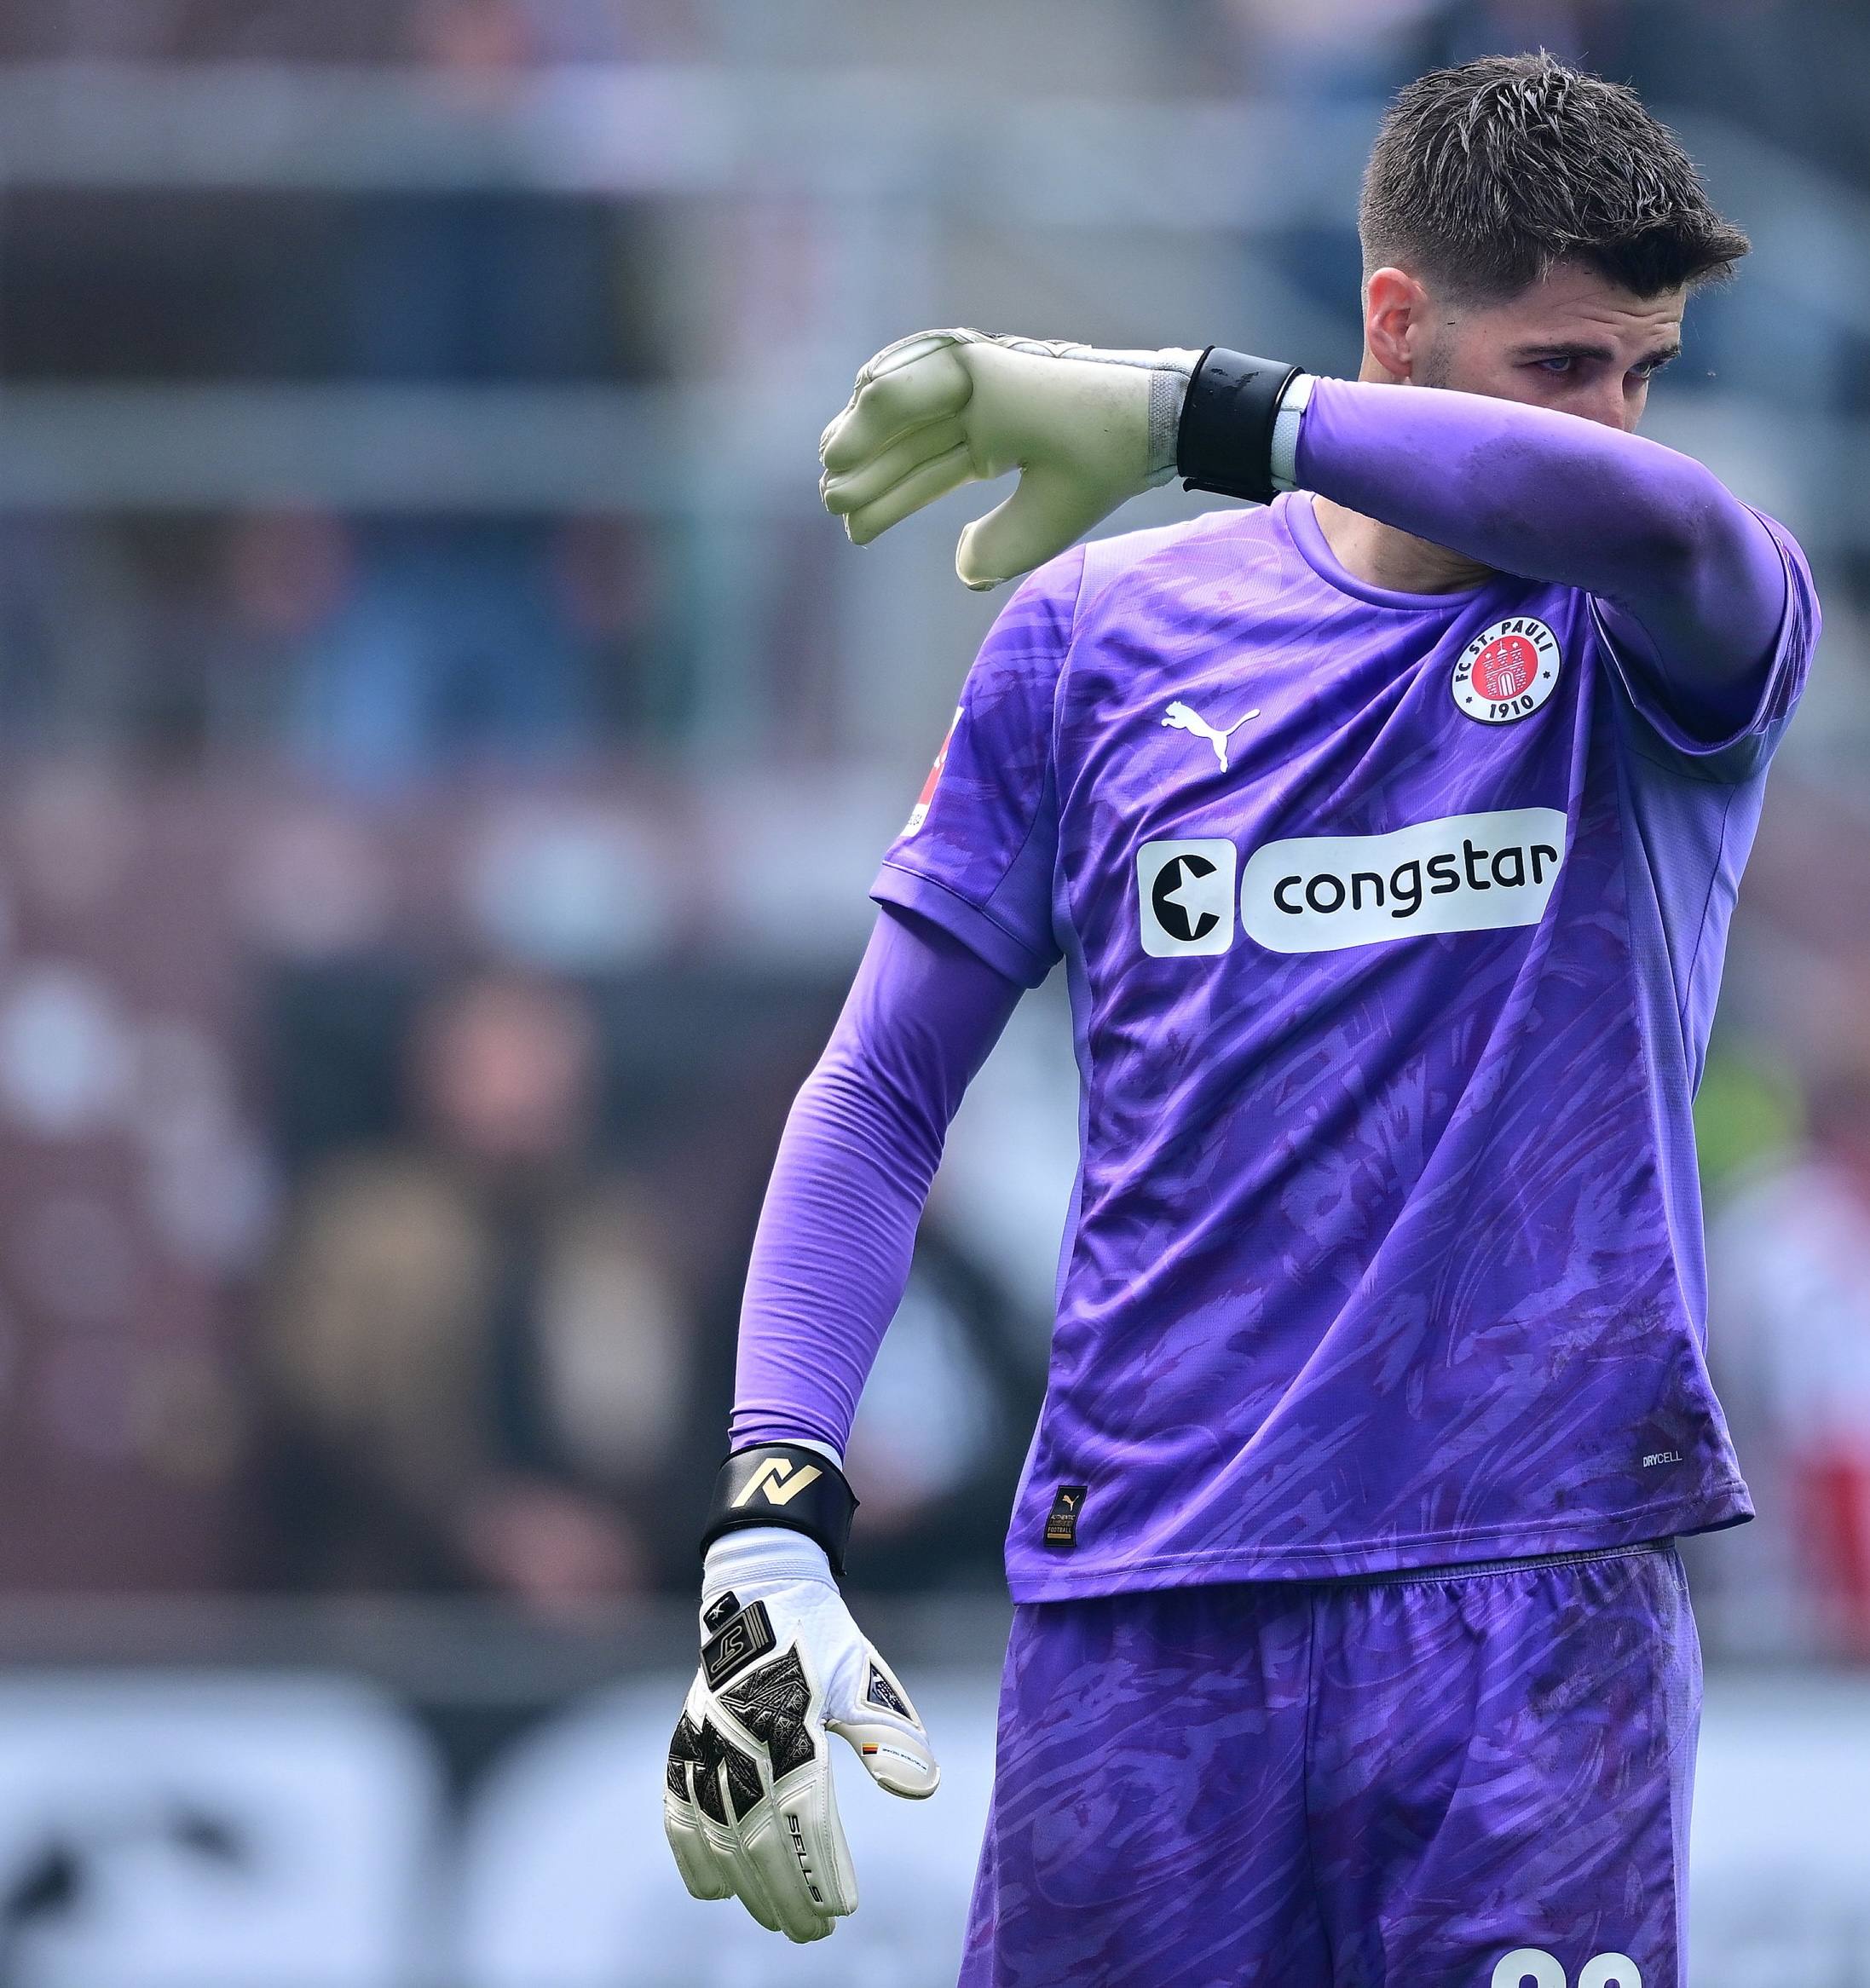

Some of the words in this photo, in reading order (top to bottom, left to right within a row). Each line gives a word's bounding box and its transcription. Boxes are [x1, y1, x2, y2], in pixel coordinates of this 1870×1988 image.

[1456, 663, 1471, 682] FC
[1469, 635, 1494, 654] ST.
[1501, 620, 1553, 652] PAULI
[1490, 695, 1533, 718] 1910
[1273, 839, 1558, 919] congstar
[1643, 1450, 1683, 1467] DRYCELL
[786, 1814, 823, 1903] SELLS
